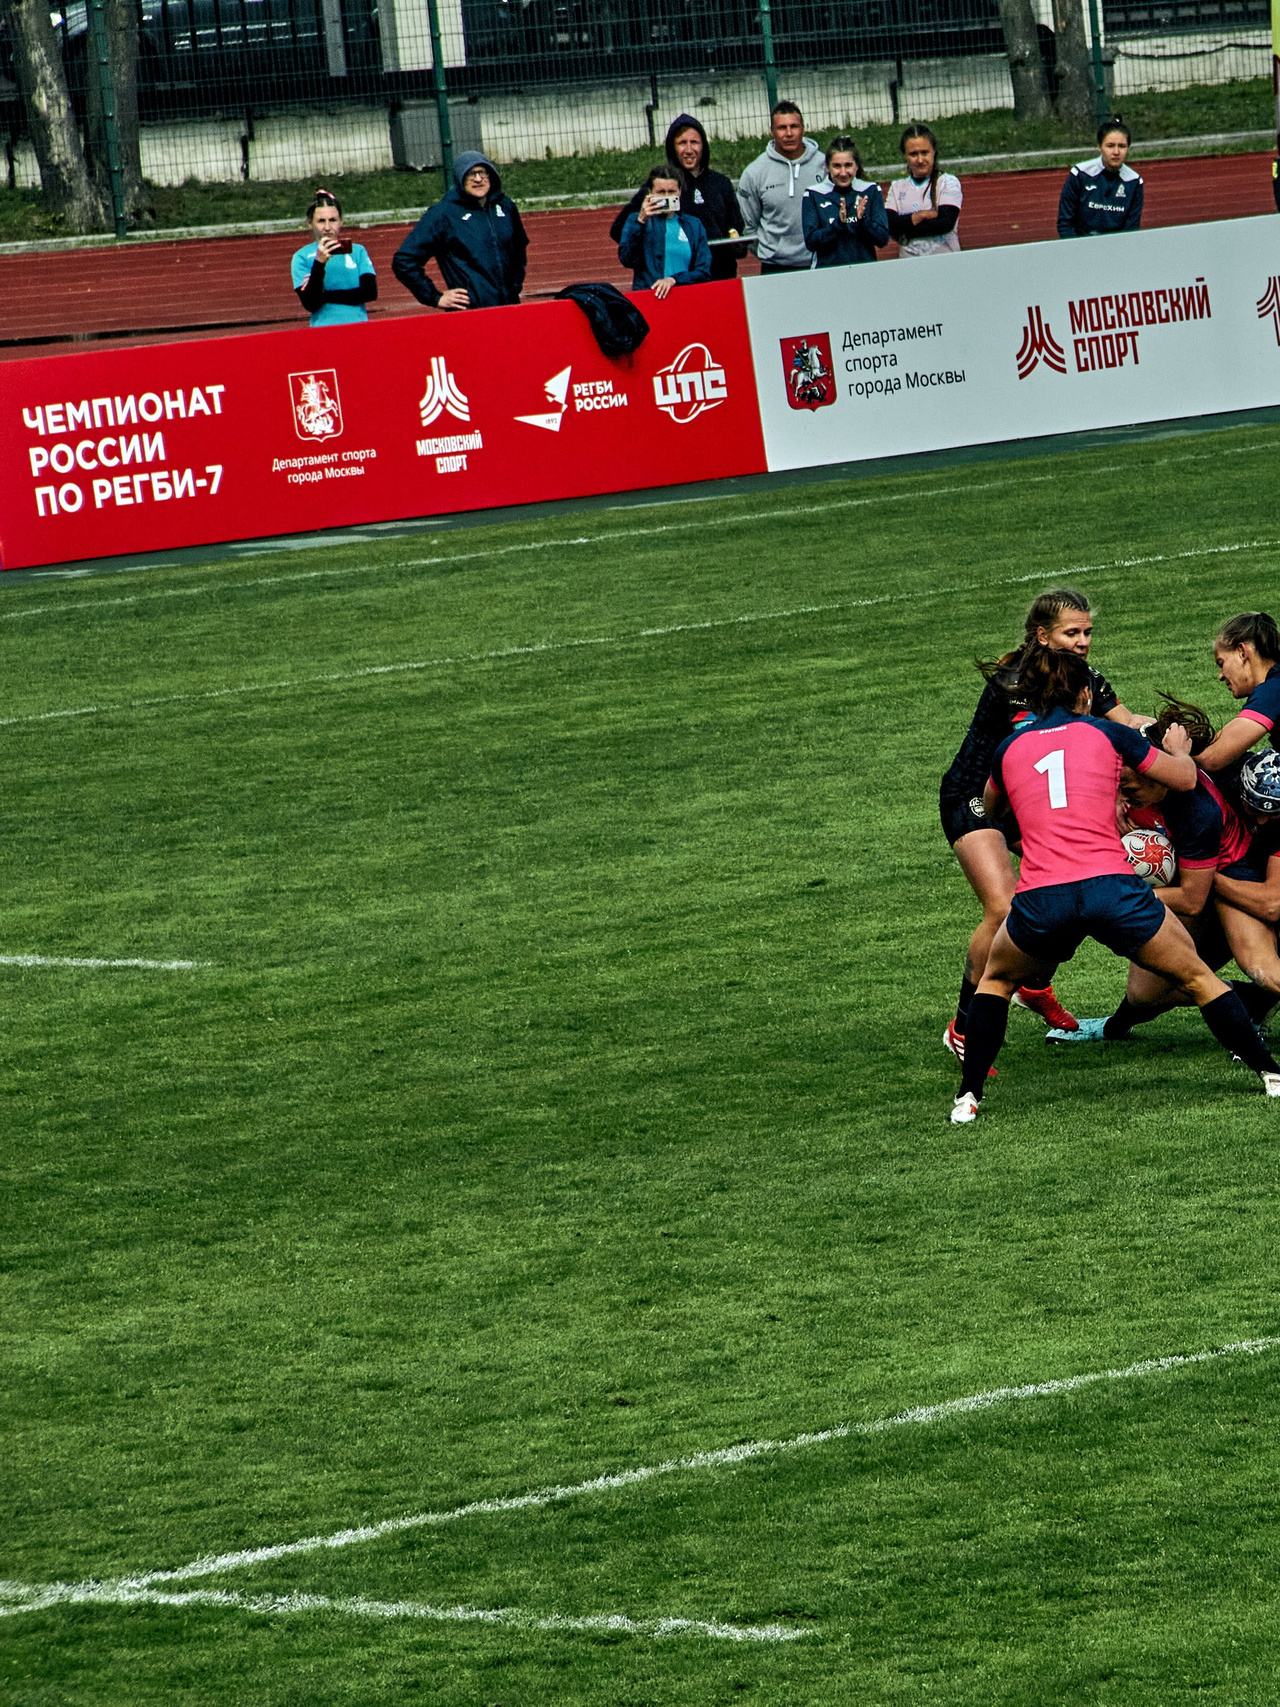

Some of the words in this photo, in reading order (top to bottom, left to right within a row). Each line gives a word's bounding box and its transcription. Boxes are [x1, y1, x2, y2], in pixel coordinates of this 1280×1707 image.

[1068, 277, 1212, 335] МОСКОВСКИЙ
[842, 323, 943, 351] Департамент
[845, 353, 898, 373] спорта
[1073, 331, 1139, 373] СПОРТ
[573, 380, 614, 397] РЕГБИ
[653, 368, 728, 406] ЦПС
[848, 376, 901, 399] города
[905, 369, 966, 389] Москвы
[22, 384, 226, 436] ЧЕМПИОНАТ
[575, 393, 628, 412] РОССИИ
[29, 431, 167, 478] РОССИИ
[416, 429, 483, 456] МОСКОВСКИЙ
[272, 452, 340, 472] Департамент
[341, 447, 377, 463] спорта
[436, 454, 468, 474] СПОРТ
[287, 469, 323, 485] города
[325, 464, 365, 479] Москвы
[35, 482, 84, 517] ПО
[92, 464, 224, 509] РЕГБИ-7
[1033, 749, 1068, 809] 1
